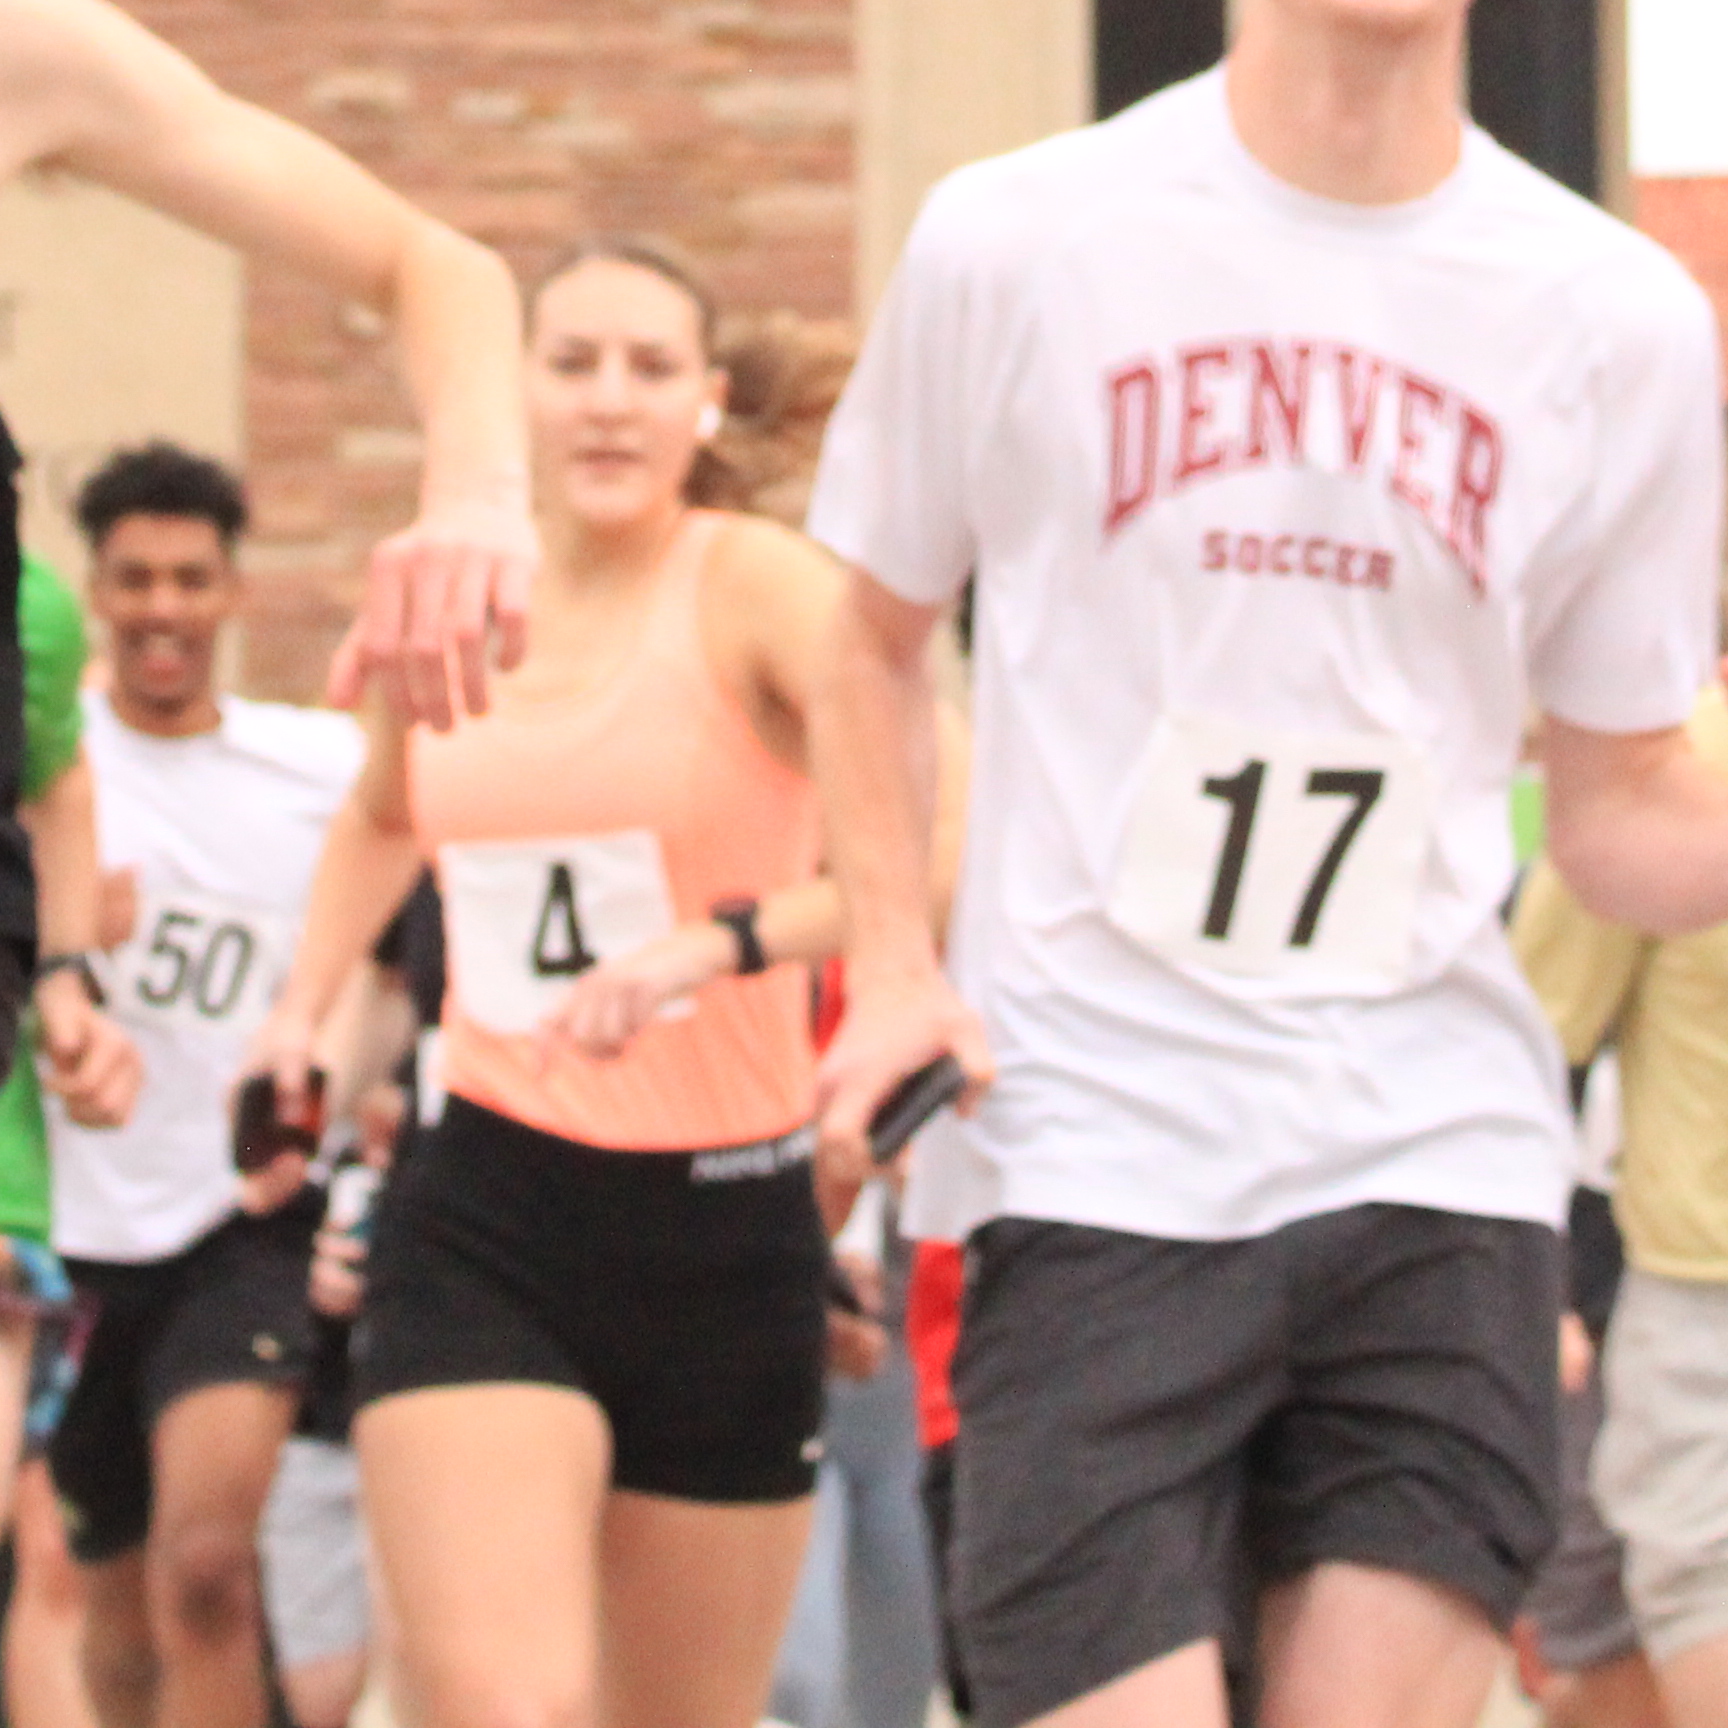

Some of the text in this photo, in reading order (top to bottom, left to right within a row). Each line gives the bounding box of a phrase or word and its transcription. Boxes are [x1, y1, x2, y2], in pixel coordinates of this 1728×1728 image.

[1102, 335, 1506, 602] DENVER
[1201, 528, 1396, 593] SOCCER
[1201, 757, 1387, 950] 17
[134, 909, 257, 1018] 50
[531, 862, 597, 977] 4
